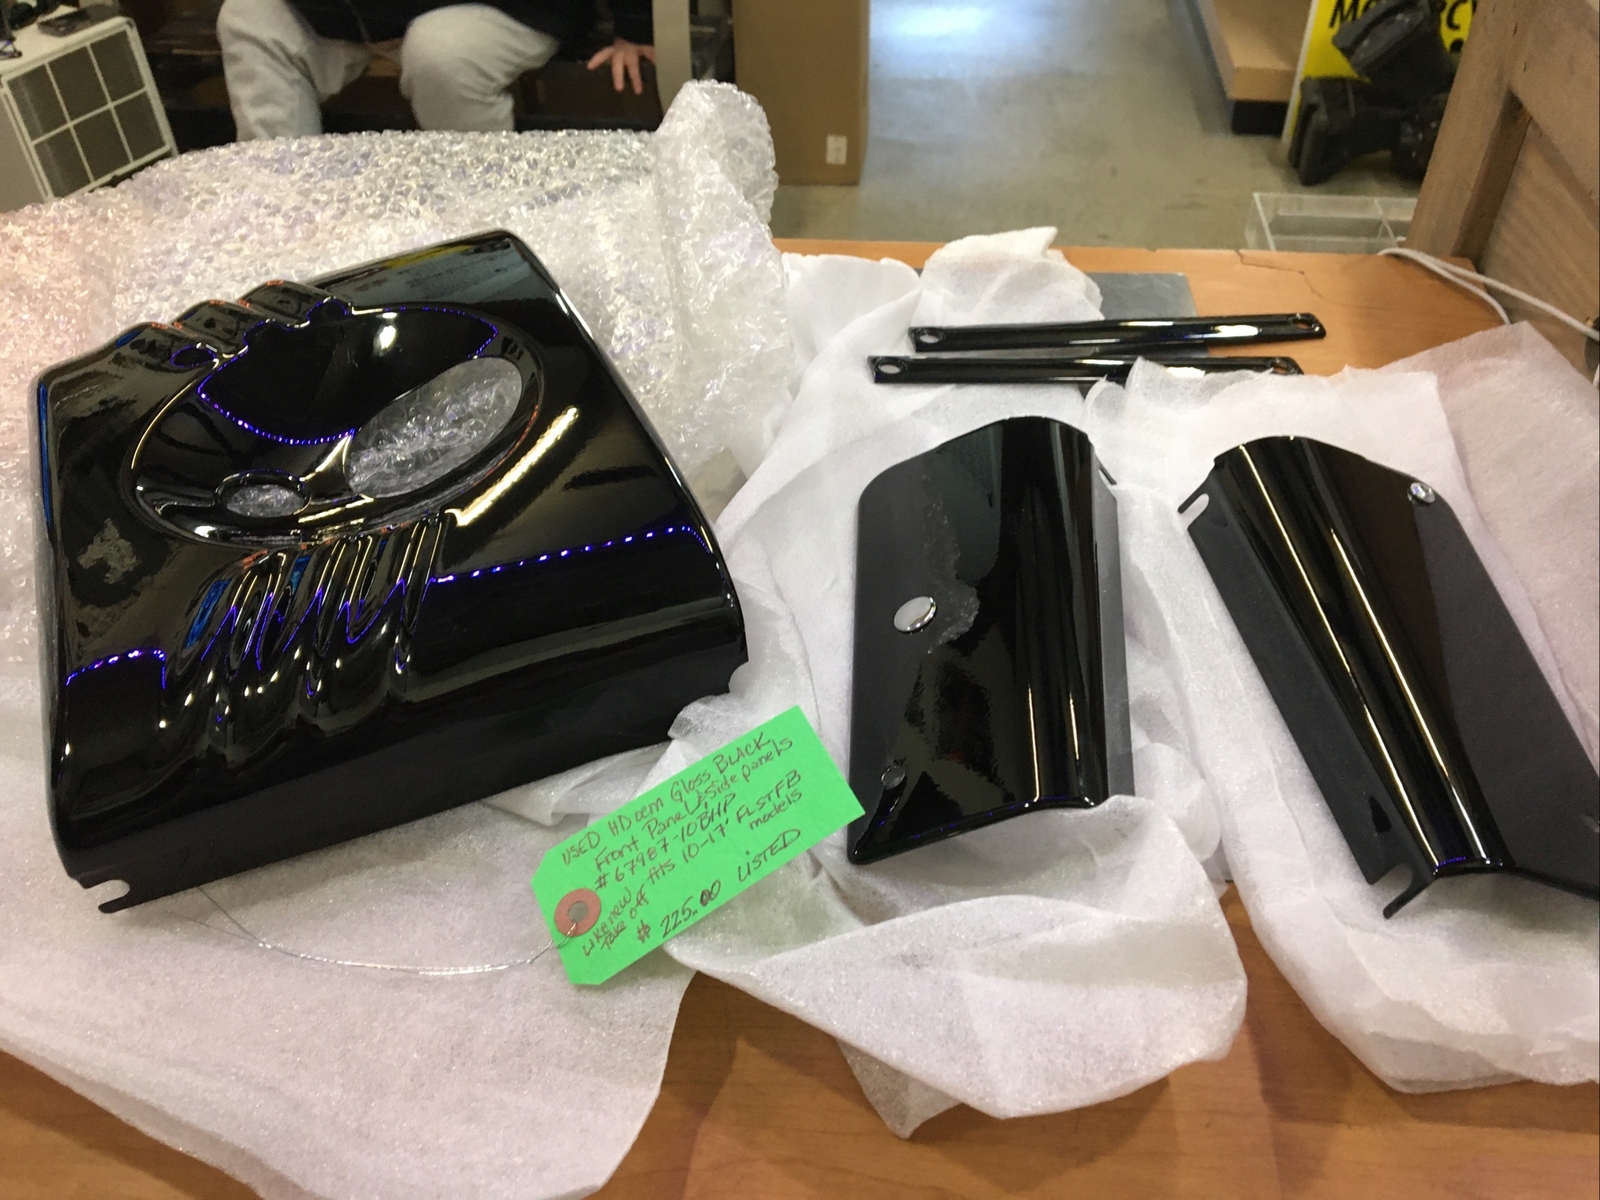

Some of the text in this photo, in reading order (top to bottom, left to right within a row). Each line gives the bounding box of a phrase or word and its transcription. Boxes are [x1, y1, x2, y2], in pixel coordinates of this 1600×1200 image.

[561, 831, 602, 867] USED
[608, 814, 633, 834] HD
[670, 767, 713, 804] Gloss
[713, 732, 772, 773] BLACK
[594, 832, 640, 872] Front
[742, 737, 793, 783] panels
[647, 858, 676, 887] fits
[736, 769, 802, 824] FLSTFB
[749, 788, 803, 831] models
[629, 884, 650, 920] off
